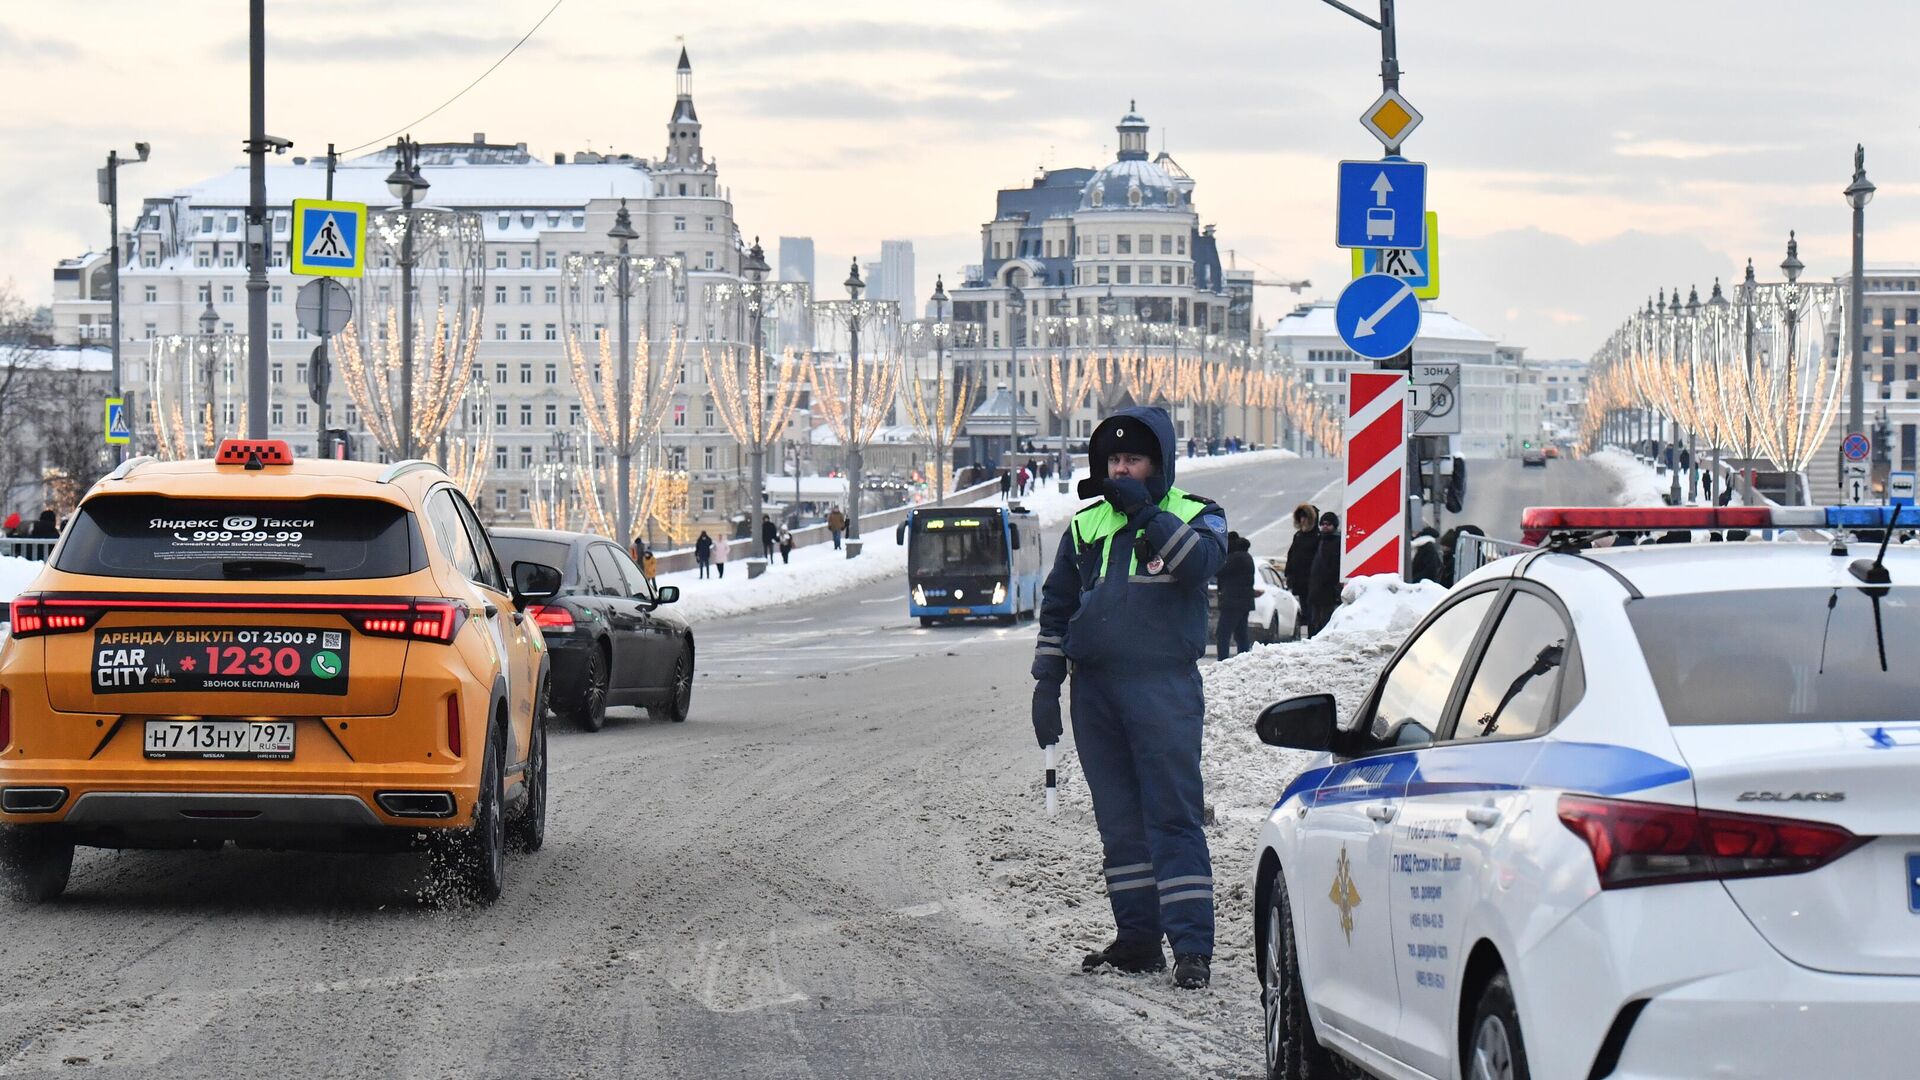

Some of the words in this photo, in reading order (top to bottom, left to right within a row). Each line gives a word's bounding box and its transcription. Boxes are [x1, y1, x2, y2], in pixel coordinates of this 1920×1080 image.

[1423, 367, 1451, 376] ЗОНА
[149, 518, 219, 529] Яндекс
[261, 517, 314, 528] Такси
[193, 531, 302, 542] 999-99-99
[238, 631, 259, 643] ОТ
[263, 631, 303, 644] 2500
[98, 649, 146, 667] CAR
[206, 646, 301, 676] 1230
[98, 667, 149, 687] CITY
[202, 680, 240, 689] ЗВОНОК
[241, 680, 300, 689] БЕСПЛАТНЫЙ
[251, 725, 288, 743] 797
[1736, 791, 1846, 802] SOLARIS
